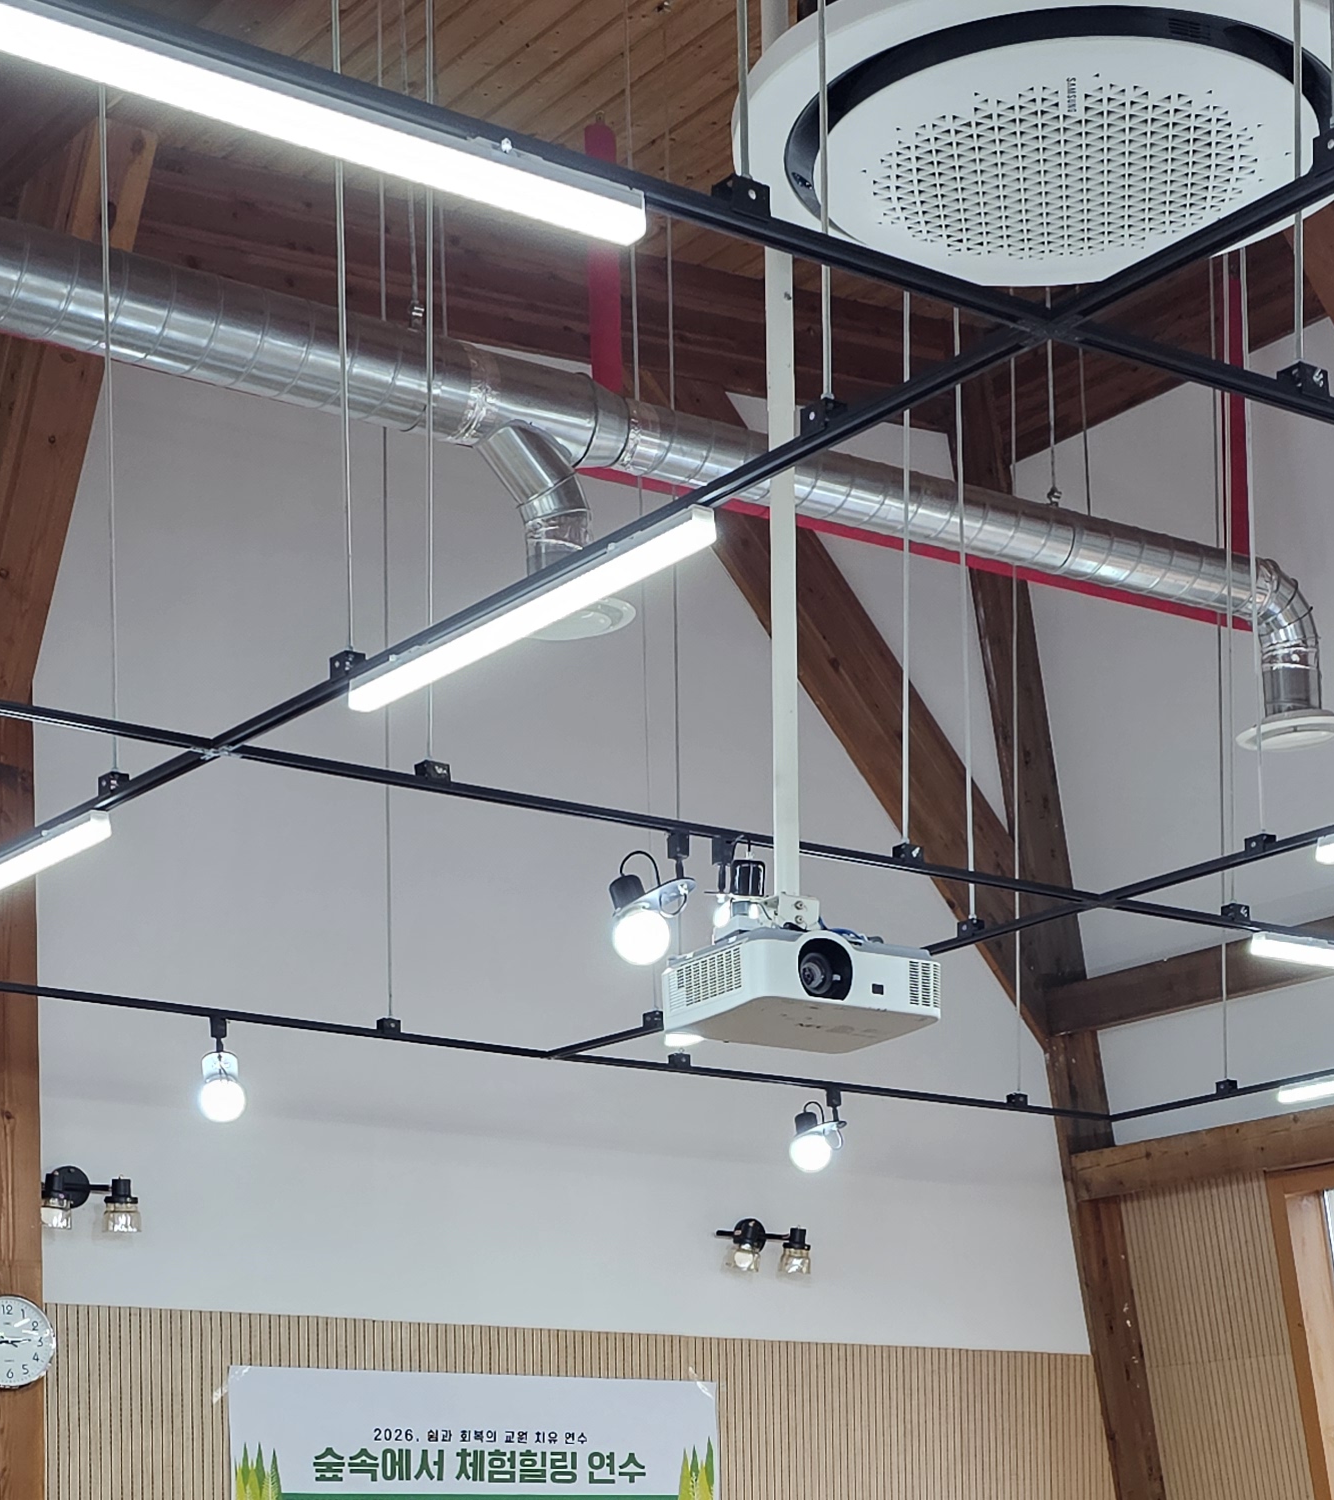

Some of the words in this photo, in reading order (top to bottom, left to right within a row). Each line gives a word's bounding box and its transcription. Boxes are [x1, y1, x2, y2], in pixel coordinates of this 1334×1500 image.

[1, 1304, 13, 1315] 12
[31, 1320, 39, 1331] 2
[32, 1352, 39, 1362] 4
[6, 1368, 14, 1379] 6
[21, 1364, 29, 1375] 5
[373, 1428, 420, 1442] 2026.
[427, 1429, 452, 1442] 쉼과
[459, 1430, 497, 1443] 회복의
[504, 1431, 528, 1444] 교원
[534, 1431, 558, 1444] 치유
[564, 1432, 588, 1445] 연수
[313, 1447, 445, 1482] 숲속에서
[455, 1448, 578, 1484] 체험힐링
[588, 1451, 647, 1484] 연수
